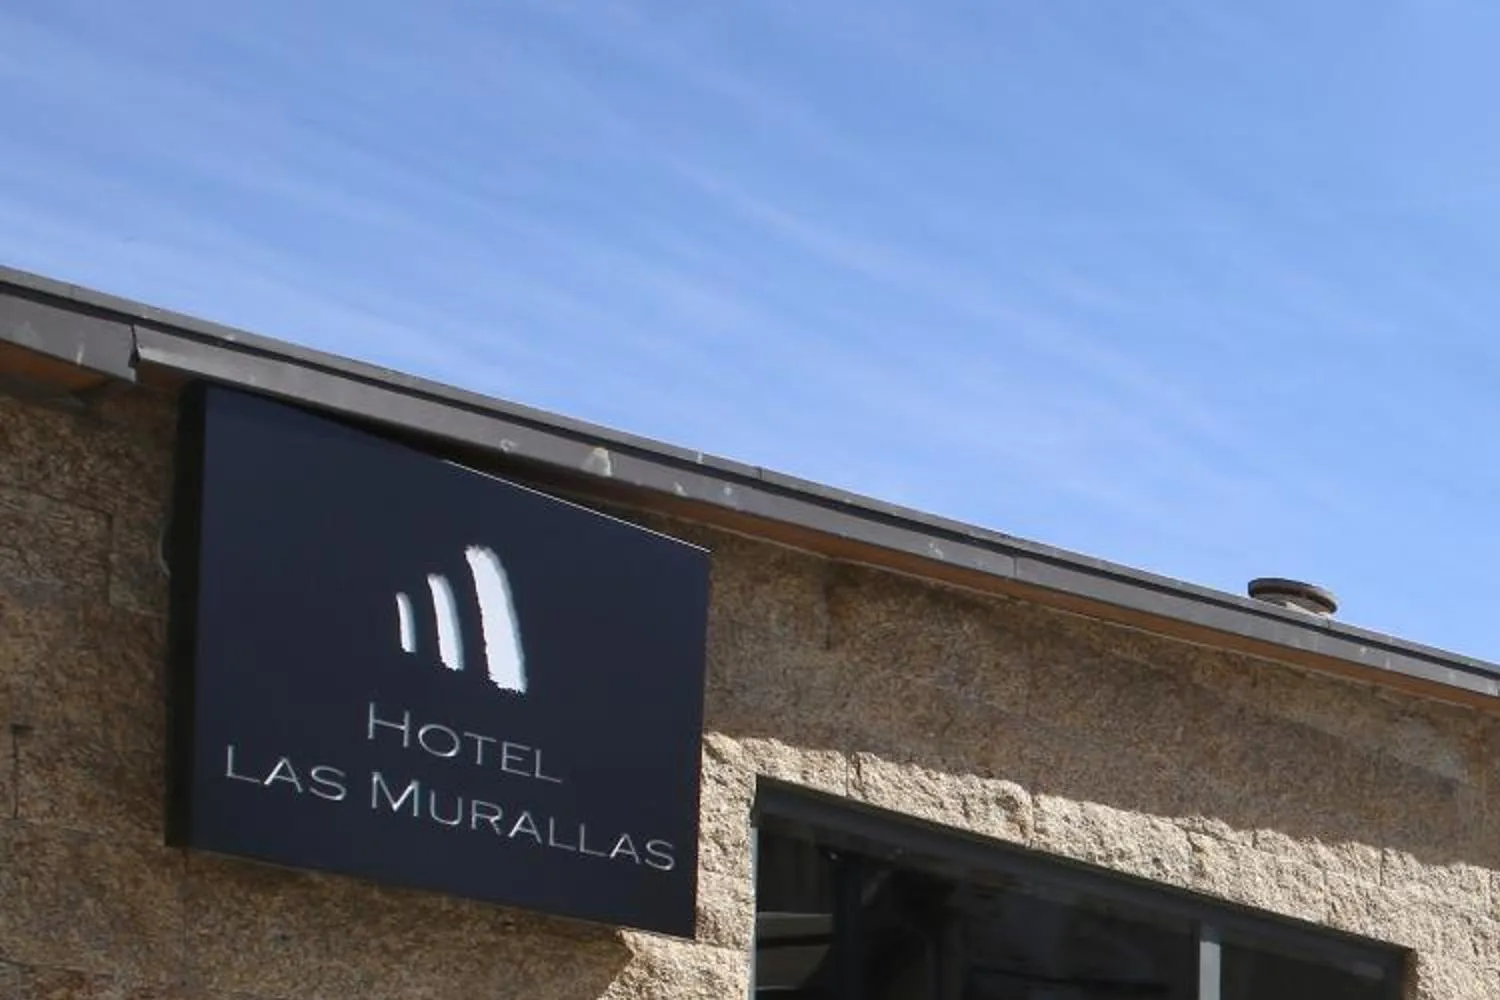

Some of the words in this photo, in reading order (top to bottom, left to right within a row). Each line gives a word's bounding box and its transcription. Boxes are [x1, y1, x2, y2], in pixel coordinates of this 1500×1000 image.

[366, 702, 563, 784] HOTEL
[226, 744, 348, 801] LAS
[371, 770, 677, 872] MURALLAS
